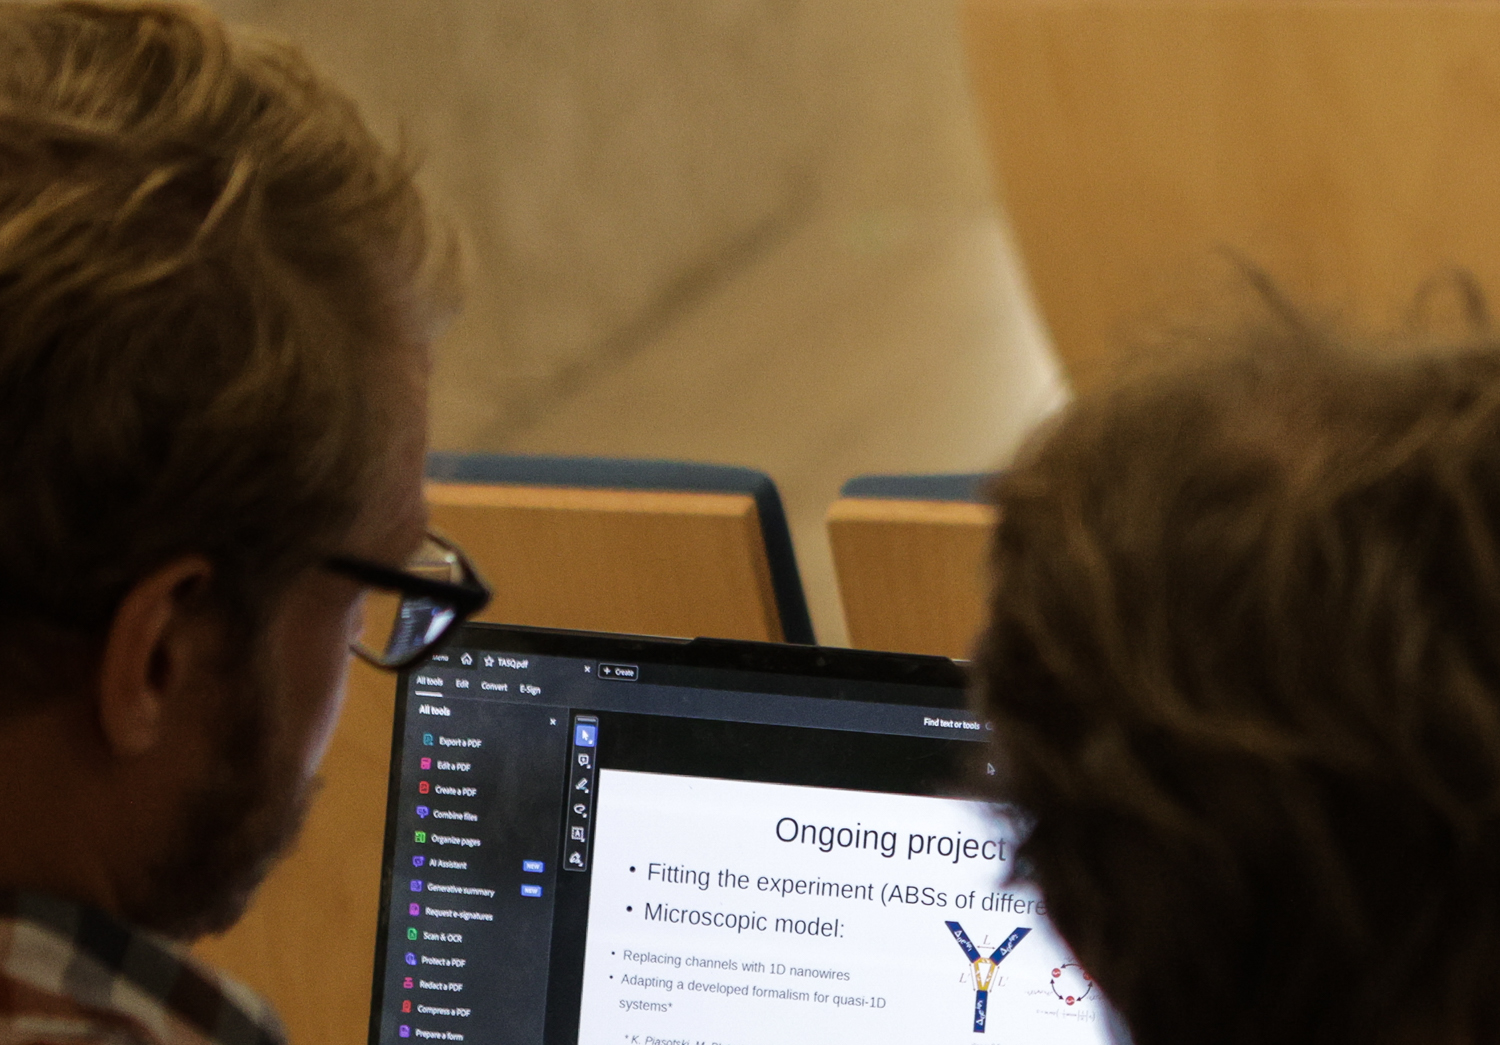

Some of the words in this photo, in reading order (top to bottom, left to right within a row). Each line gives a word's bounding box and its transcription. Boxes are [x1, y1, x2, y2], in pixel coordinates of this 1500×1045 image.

[615, 668, 635, 677] Create
[427, 677, 444, 687] tools
[456, 679, 470, 689] Edit
[481, 681, 508, 692] Convert
[520, 684, 541, 696] E-Sign
[431, 706, 451, 717] tools
[924, 717, 939, 728] Find
[940, 719, 953, 729] text
[963, 720, 980, 730] tools
[439, 736, 461, 749] Export
[437, 761, 451, 771] Edit
[435, 786, 457, 796] Create
[433, 810, 463, 821] Combine
[431, 834, 460, 847] Organize
[776, 817, 897, 858] Ongoing
[908, 832, 1007, 864] project
[438, 859, 468, 870] Assistant
[427, 883, 463, 895] Generative
[463, 888, 496, 898] summary
[648, 862, 710, 890] Fitting
[718, 869, 750, 890] the
[757, 876, 874, 901] experiment
[881, 883, 947, 907] (ABSs
[955, 891, 975, 909] of
[425, 907, 452, 919] Request
[453, 911, 493, 922] e-signatures
[644, 902, 767, 934] Microscopic
[775, 917, 845, 938] model:
[424, 932, 440, 942] Scan
[447, 934, 463, 943] OCR
[421, 956, 446, 967] Protect
[623, 950, 682, 969] Replacing
[685, 956, 738, 971] channels
[742, 960, 765, 974] with
[770, 963, 786, 975] 1D
[790, 966, 851, 982] nanowires
[420, 980, 443, 991] Redact
[620, 974, 673, 992] Adapting
[677, 980, 684, 990] a
[688, 980, 749, 997] developed
[752, 986, 810, 1002] formalism
[814, 991, 830, 1003] for
[832, 994, 886, 1009] quasi-1D
[417, 1004, 450, 1017] Compress
[416, 1029, 441, 1041] Prepare
[632, 1035, 641, 1045] K.
